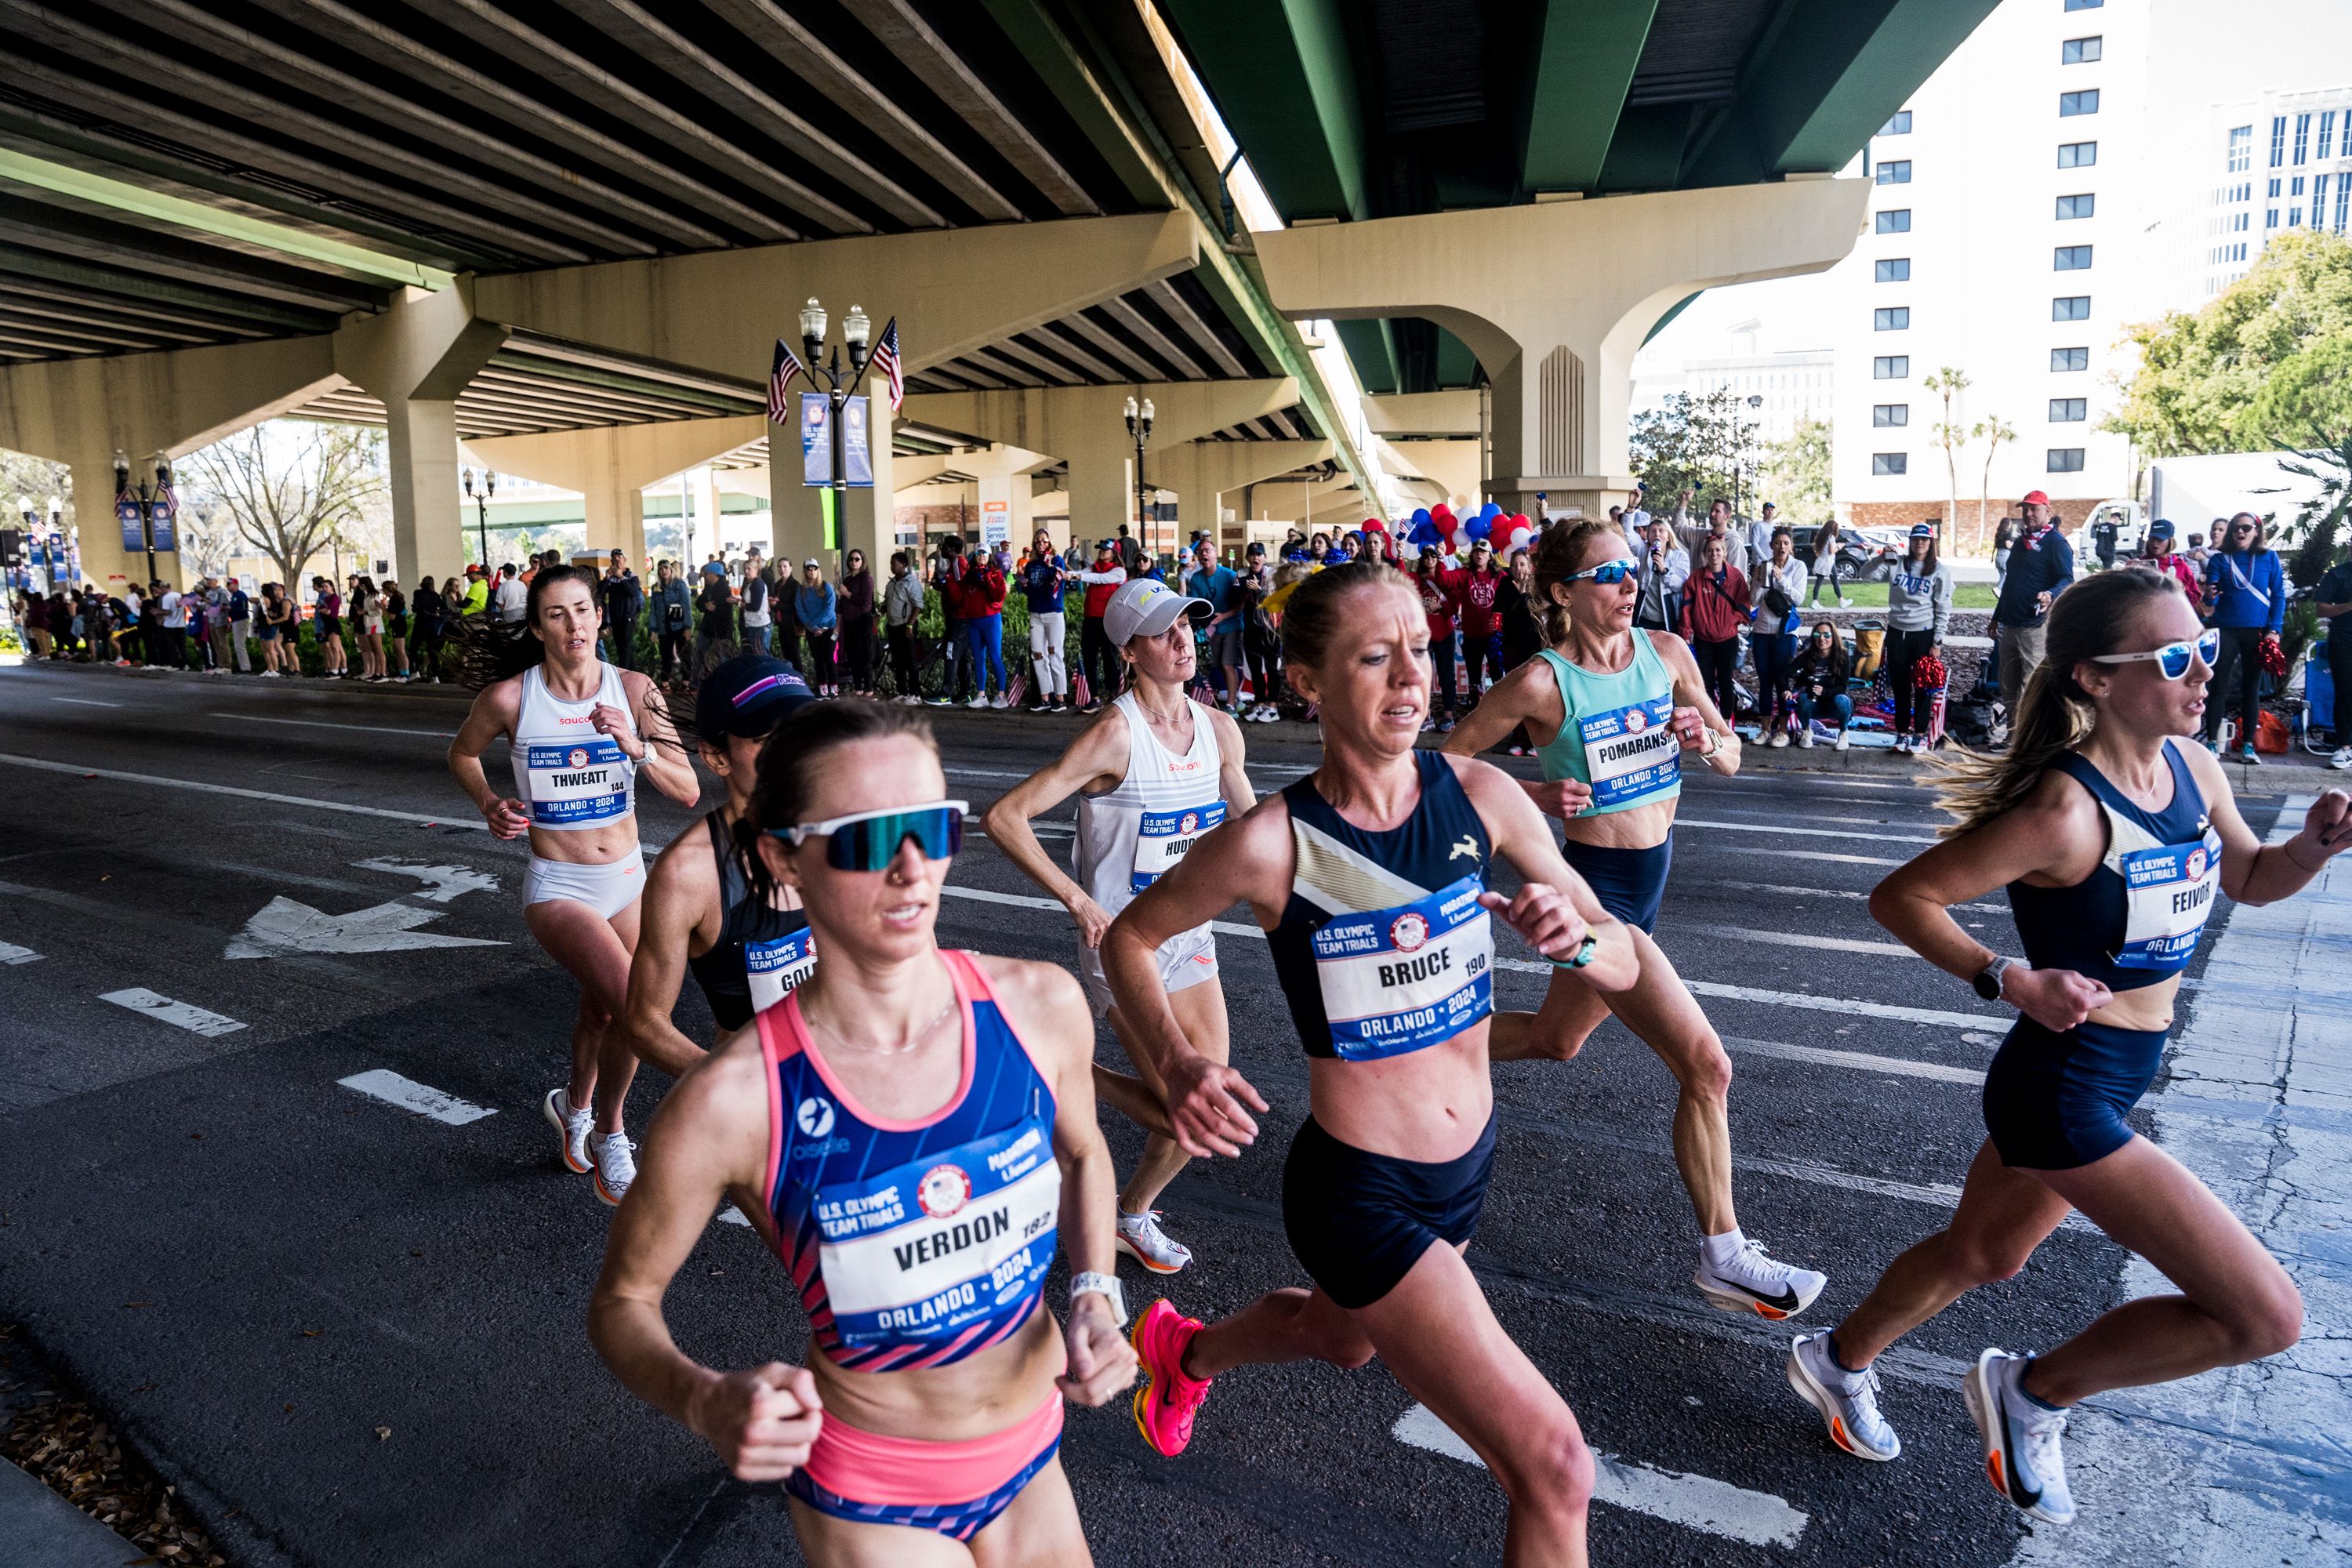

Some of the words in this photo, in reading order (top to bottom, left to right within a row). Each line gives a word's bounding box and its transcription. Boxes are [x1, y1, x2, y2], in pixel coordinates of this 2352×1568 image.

[559, 716, 591, 724] sauco
[1584, 723, 1595, 732] U.S.
[1594, 717, 1617, 728] OLYMPIC
[1584, 731, 1601, 740] TEAM
[1600, 725, 1620, 736] TRIALS
[1168, 761, 1201, 771] saucony
[552, 770, 608, 788] THWEATT
[1611, 769, 1652, 790] ORLANDO
[1658, 761, 1675, 775] 2024
[611, 782, 624, 792] 144
[547, 800, 587, 812] ORLANDO
[596, 796, 615, 808] 2024
[1156, 818, 1176, 826] OLYMPIC
[2129, 862, 2143, 873] U.S.
[2143, 856, 2176, 870] OLYMPIC
[2130, 873, 2151, 884] TEAM
[2151, 867, 2177, 880] TRIALS
[1439, 887, 1479, 916] MARATHON
[2172, 880, 2210, 914] FEIVOR
[1316, 930, 1334, 942] U.S.
[1334, 924, 1375, 940] OLYMPIC
[2146, 931, 2196, 953] ORLANDO
[750, 952, 764, 960] U.S.
[765, 942, 795, 958] OLYMPIC
[1317, 941, 1344, 954] TEAM
[1345, 937, 1378, 952] TRIALS
[750, 960, 771, 970] TEAM
[773, 950, 797, 966] TRIALS
[1377, 947, 1450, 988] BRUCE
[1465, 953, 1485, 978] 190
[1360, 1007, 1436, 1038] ORLANDO
[1448, 985, 1477, 1014] 2024
[818, 1201, 843, 1221] U.S.
[844, 1186, 900, 1215] OLYMPIC
[822, 1216, 859, 1238] TEAM
[861, 1203, 905, 1227] TRIALS
[893, 1206, 1011, 1272] VERDON
[877, 1282, 976, 1329] ORLANDO
[991, 1247, 1033, 1290] 2024
